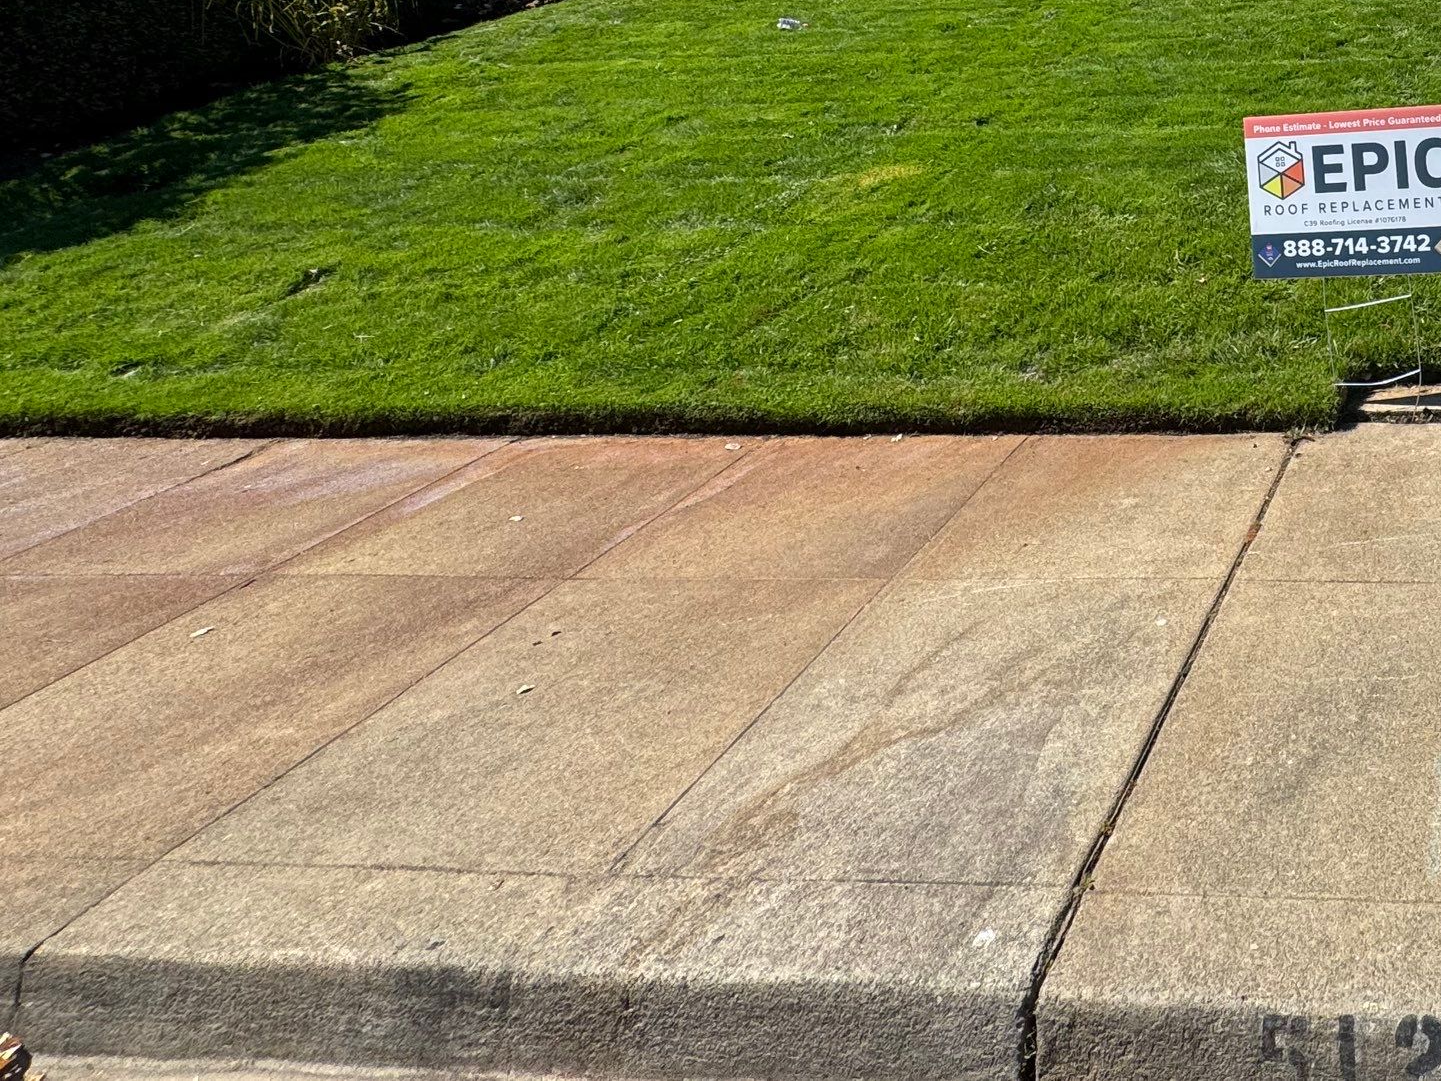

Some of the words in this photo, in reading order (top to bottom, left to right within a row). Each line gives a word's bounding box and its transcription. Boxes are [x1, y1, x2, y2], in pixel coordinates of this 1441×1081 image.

[1253, 125, 1281, 134] Phone
[1283, 123, 1321, 132] Estimate
[1329, 120, 1361, 129] Lowest
[1363, 117, 1385, 127] Price
[1264, 203, 1309, 216] ROOF
[1320, 218, 1345, 227] Roofing
[1347, 217, 1373, 225] License
[1283, 234, 1431, 257] 888-714-3742
[1296, 256, 1421, 269] www.EpicRoofReplacement.com
